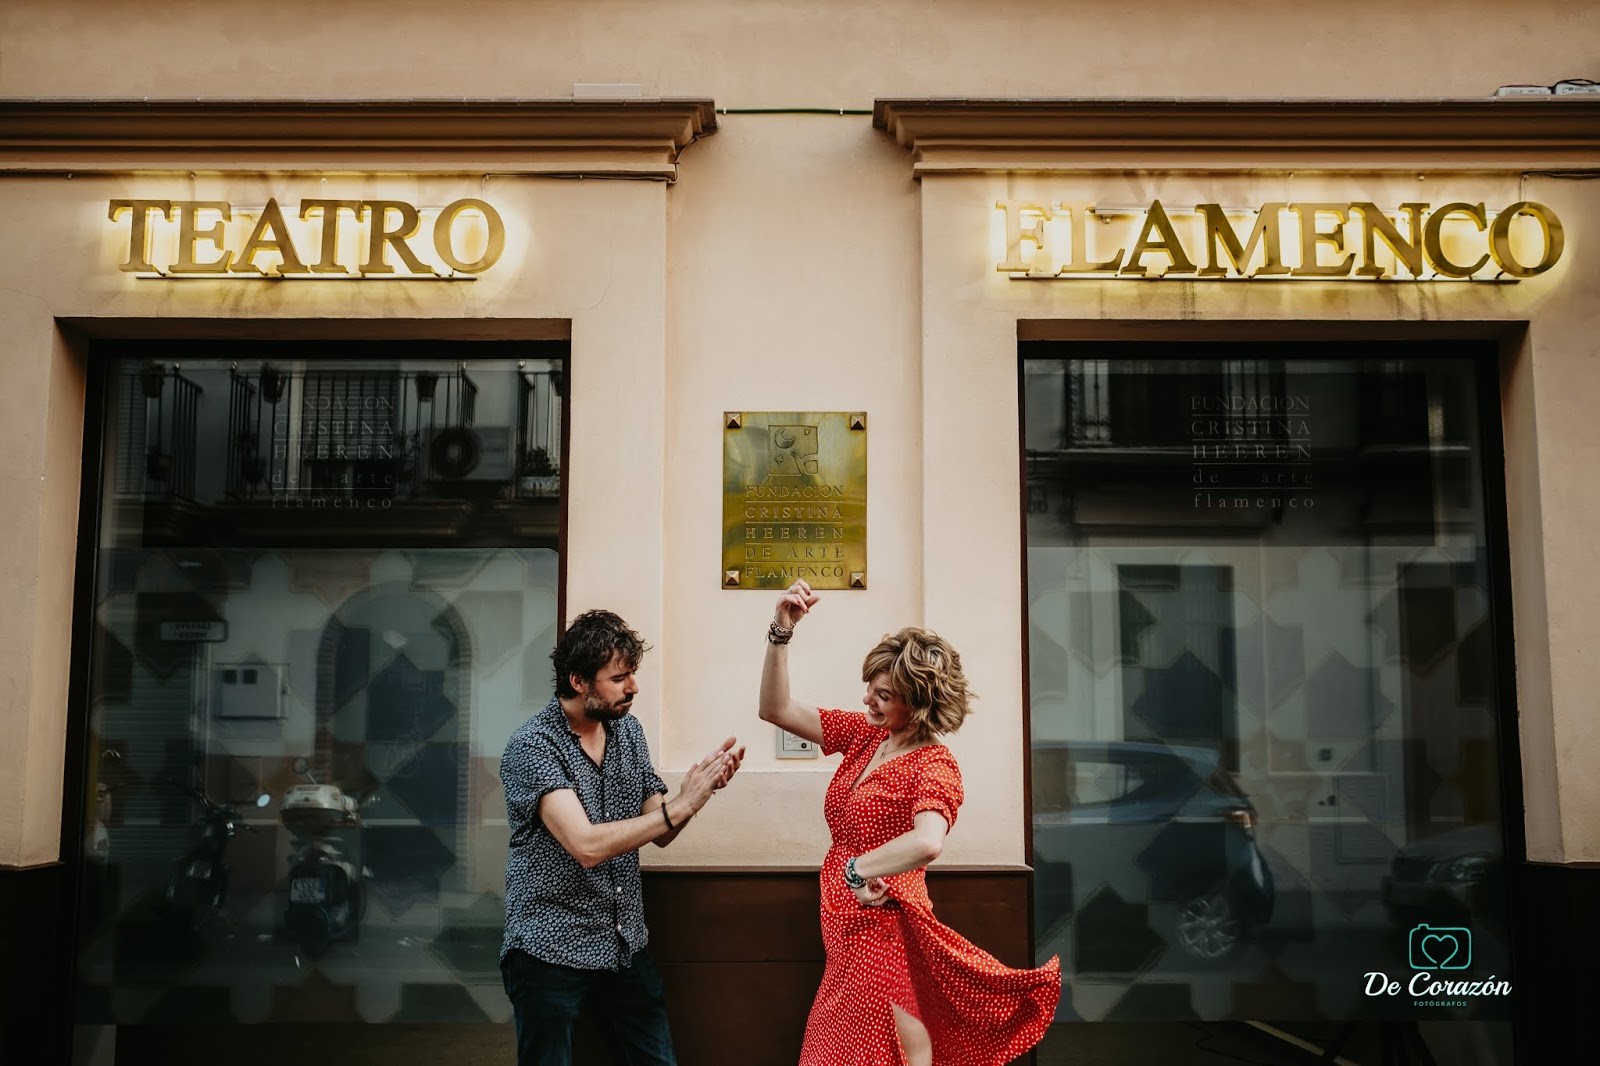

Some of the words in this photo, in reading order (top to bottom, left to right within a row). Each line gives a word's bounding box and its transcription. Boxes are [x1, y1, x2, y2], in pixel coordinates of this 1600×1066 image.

[108, 197, 505, 274] TEATRO
[995, 199, 1565, 278] FLAMENCO
[1191, 395, 1310, 411] FUNDACION
[274, 420, 393, 435] CRISTINA
[1191, 420, 1310, 435] CRISTINA
[274, 444, 393, 459] HEEREN
[1193, 444, 1312, 459] HEEREN
[272, 469, 297, 484] de
[340, 472, 392, 484] arte
[1193, 469, 1218, 484] de
[1261, 472, 1312, 484] arte
[745, 485, 844, 498] FUNDACION
[272, 493, 392, 508] flamenco
[1194, 493, 1314, 508] flamenco
[745, 507, 843, 519] CRISTINA
[745, 527, 844, 539] HEEREN
[745, 547, 771, 559] DE
[787, 547, 845, 559] ARTE
[745, 566, 844, 578] FLAMENCO
